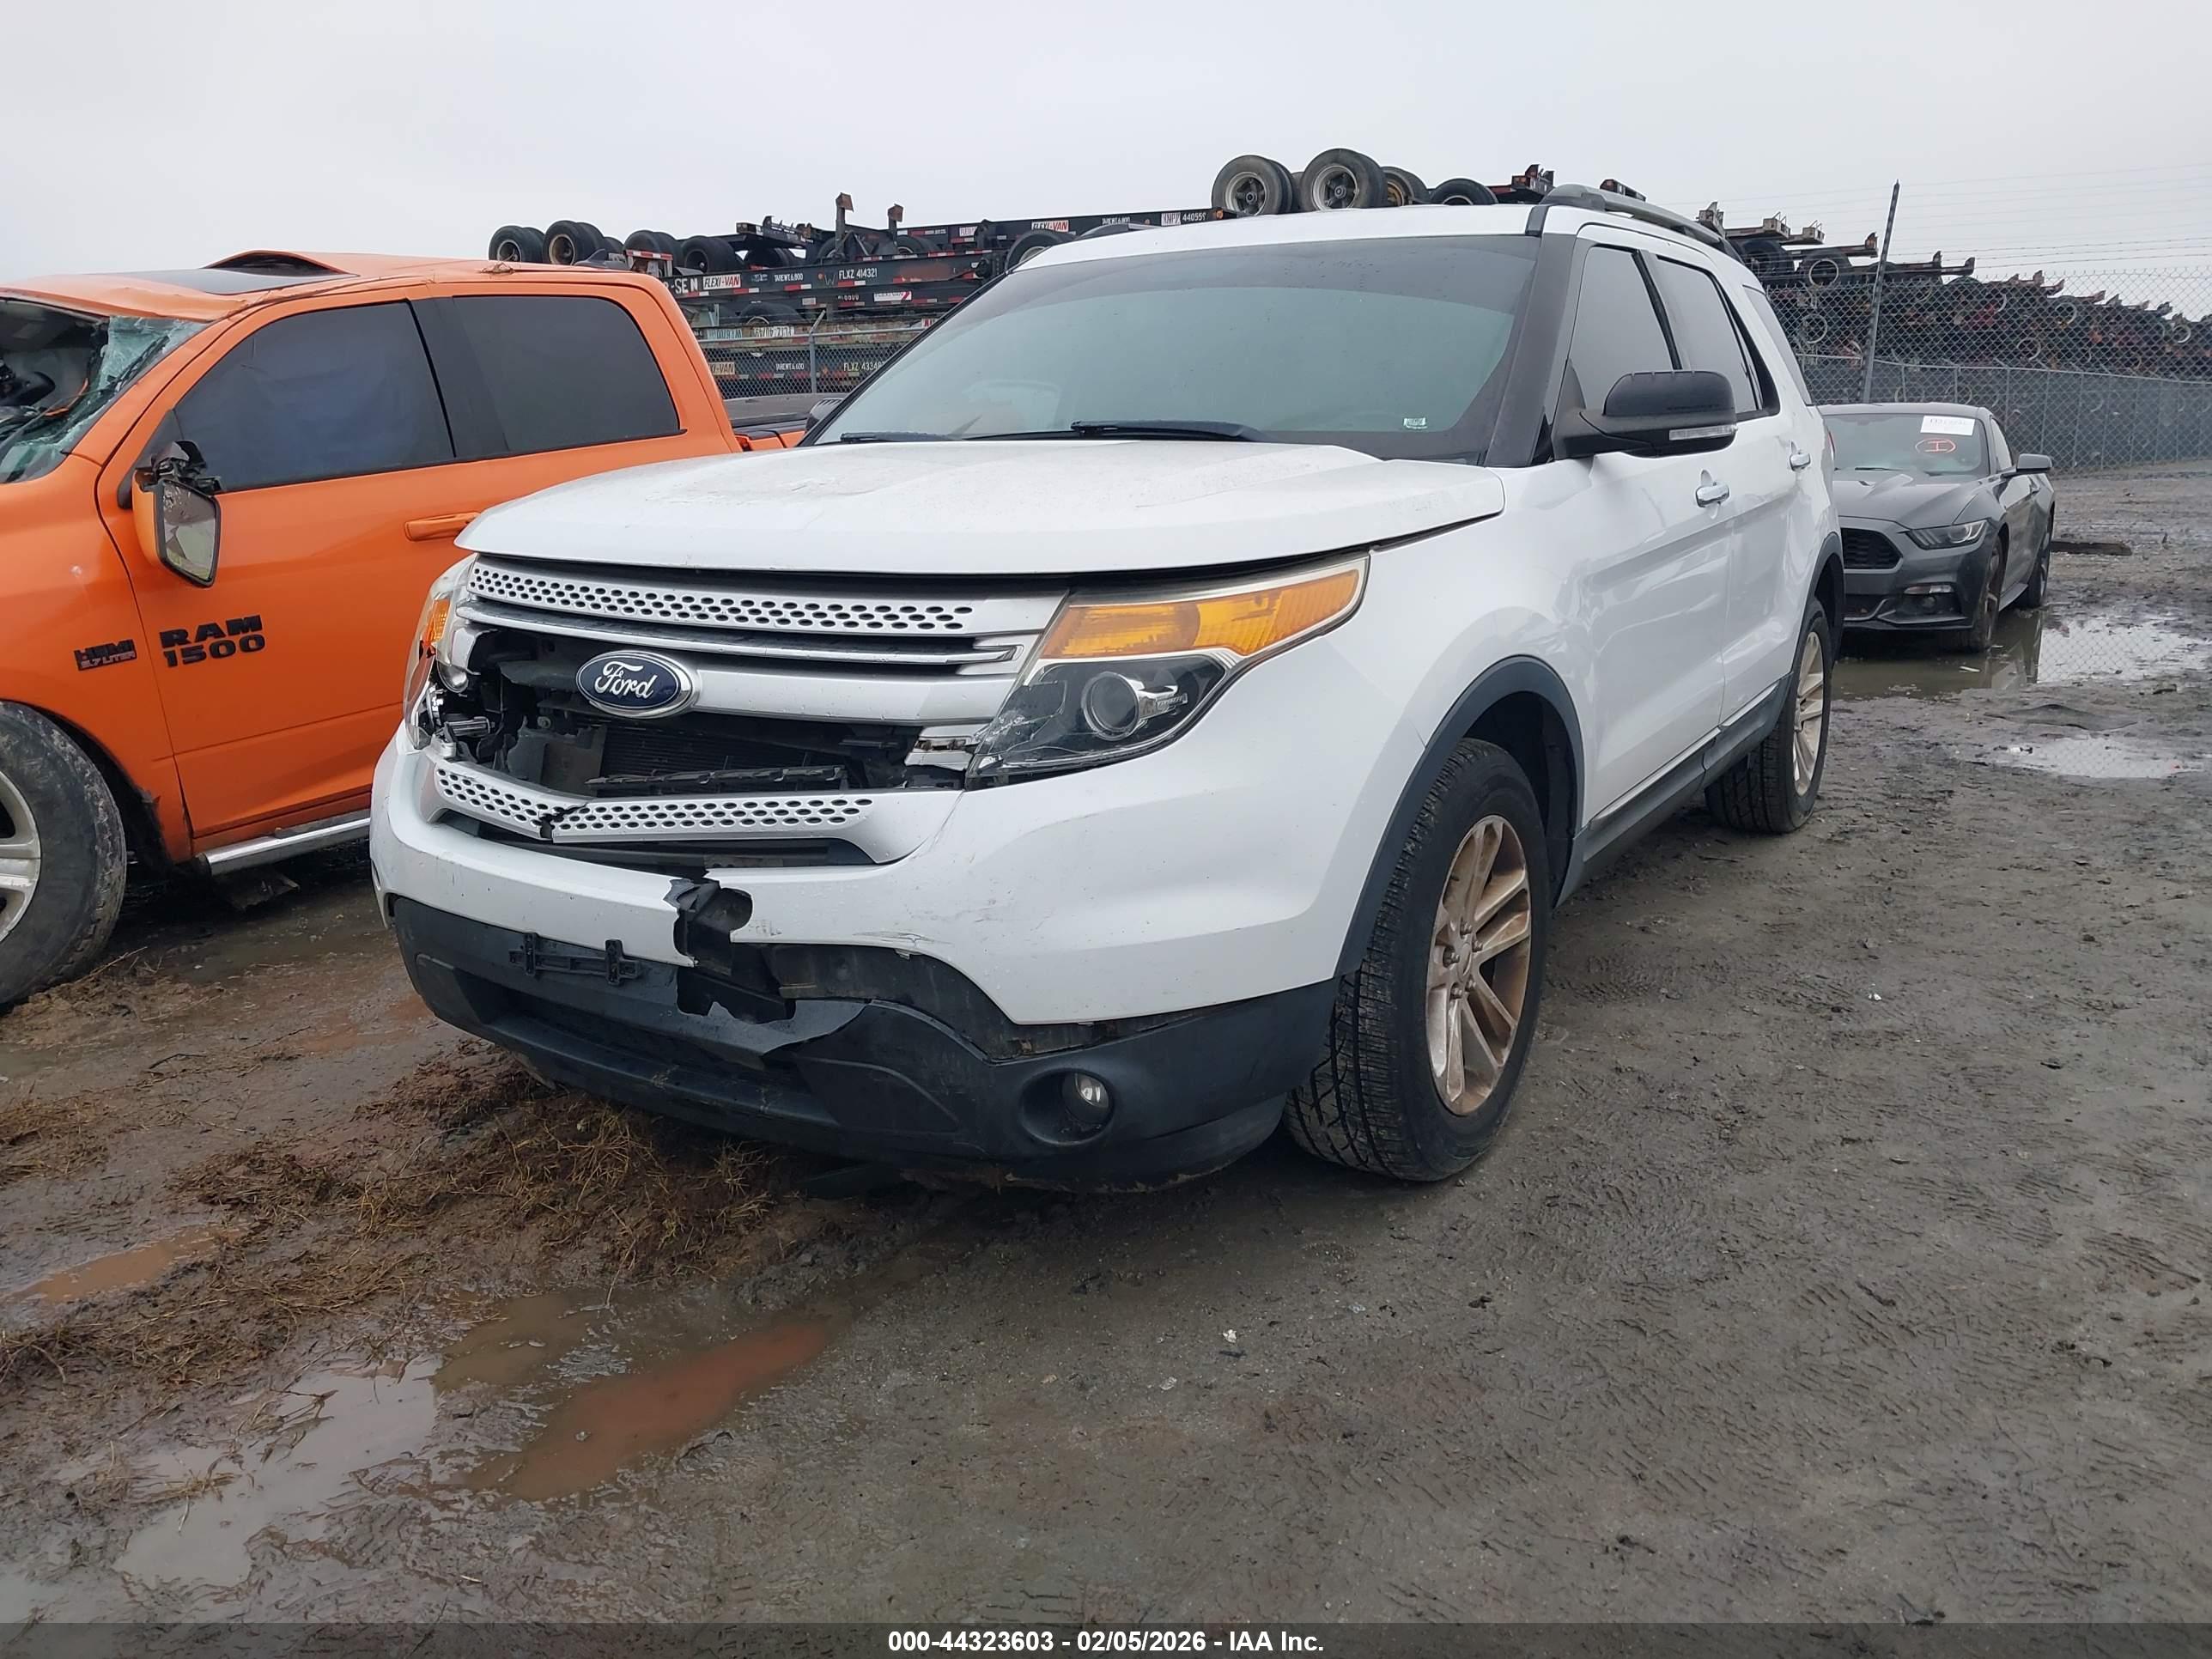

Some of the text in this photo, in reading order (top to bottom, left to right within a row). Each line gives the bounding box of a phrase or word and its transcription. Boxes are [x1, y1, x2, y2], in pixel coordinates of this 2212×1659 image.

[704, 275, 739, 289] FLEXI-VAN
[838, 267, 878, 279] FLXZ 414321
[843, 362, 859, 371] FLXZ
[159, 615, 262, 648] RAM
[163, 634, 265, 667] 1500
[594, 660, 658, 699] Ford
